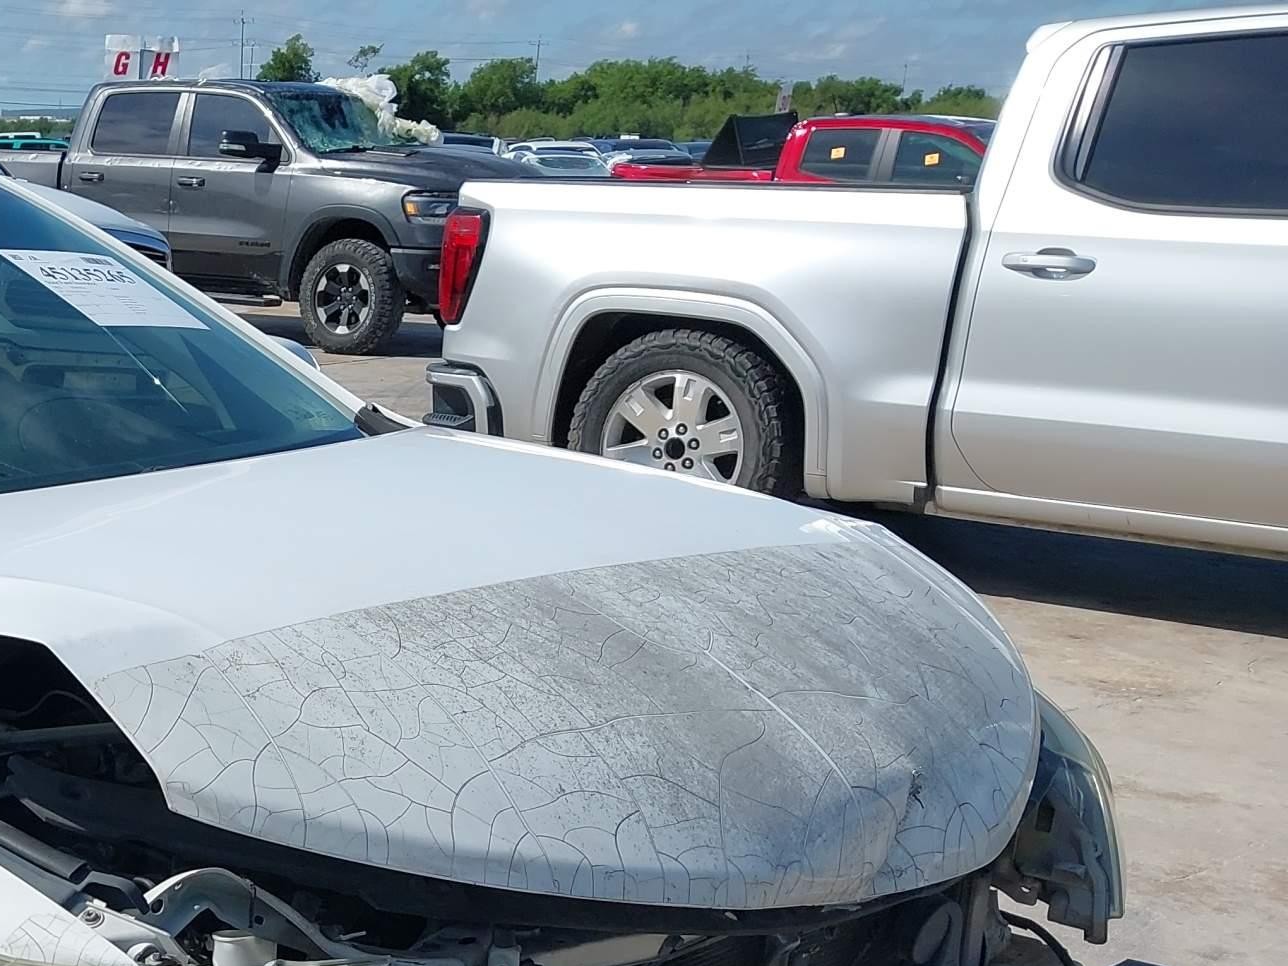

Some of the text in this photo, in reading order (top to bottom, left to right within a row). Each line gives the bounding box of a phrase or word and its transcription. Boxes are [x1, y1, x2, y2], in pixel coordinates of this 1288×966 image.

[113, 51, 130, 76] G
[150, 52, 171, 78] H
[39, 265, 137, 285] 45135265
